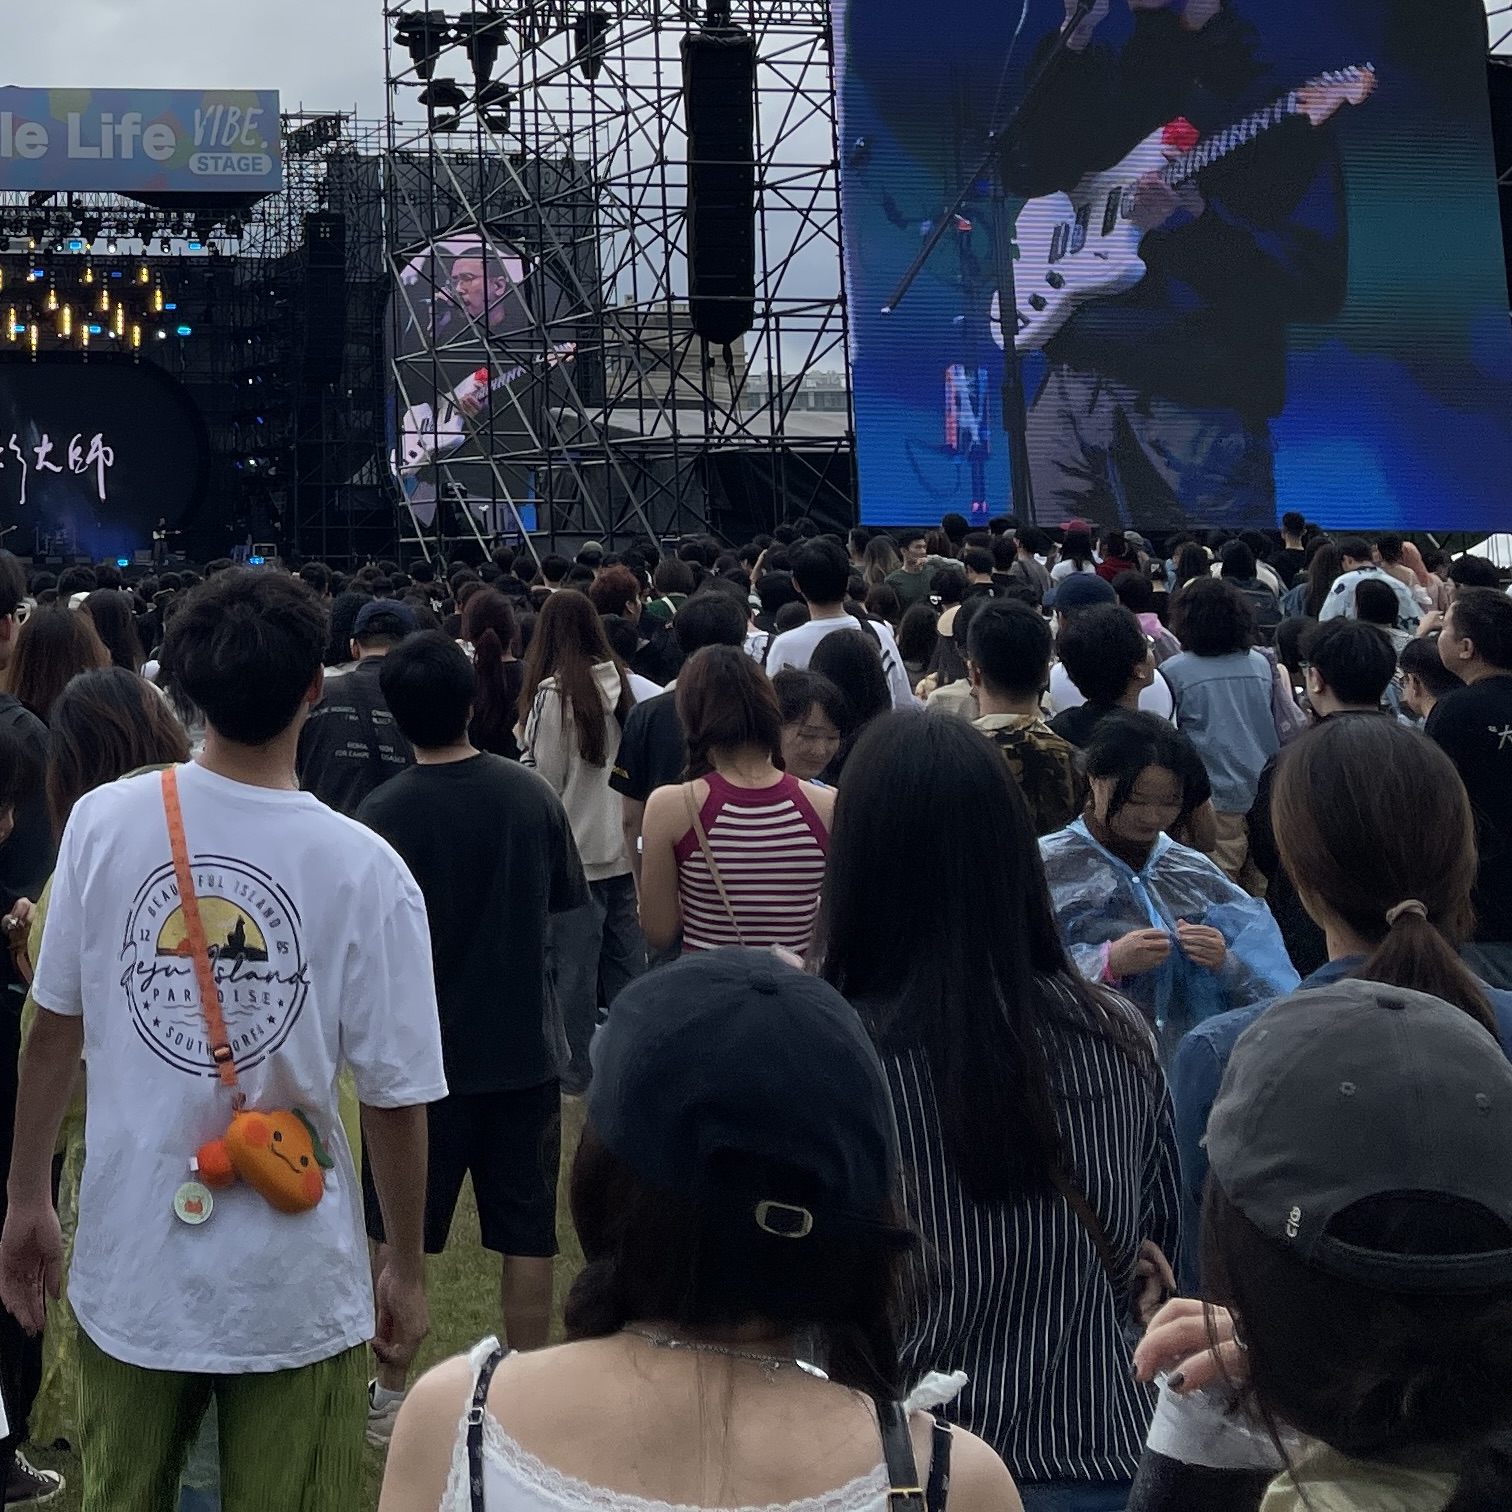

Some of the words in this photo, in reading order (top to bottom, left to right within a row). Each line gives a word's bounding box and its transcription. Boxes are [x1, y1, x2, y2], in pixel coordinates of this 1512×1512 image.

[67, 110, 176, 161] Life
[197, 155, 263, 173] STAGE
[233, 880, 281, 929] ISLAND
[140, 928, 151, 942] 12
[153, 988, 271, 1006] PARDISE
[229, 1023, 265, 1053] OREA
